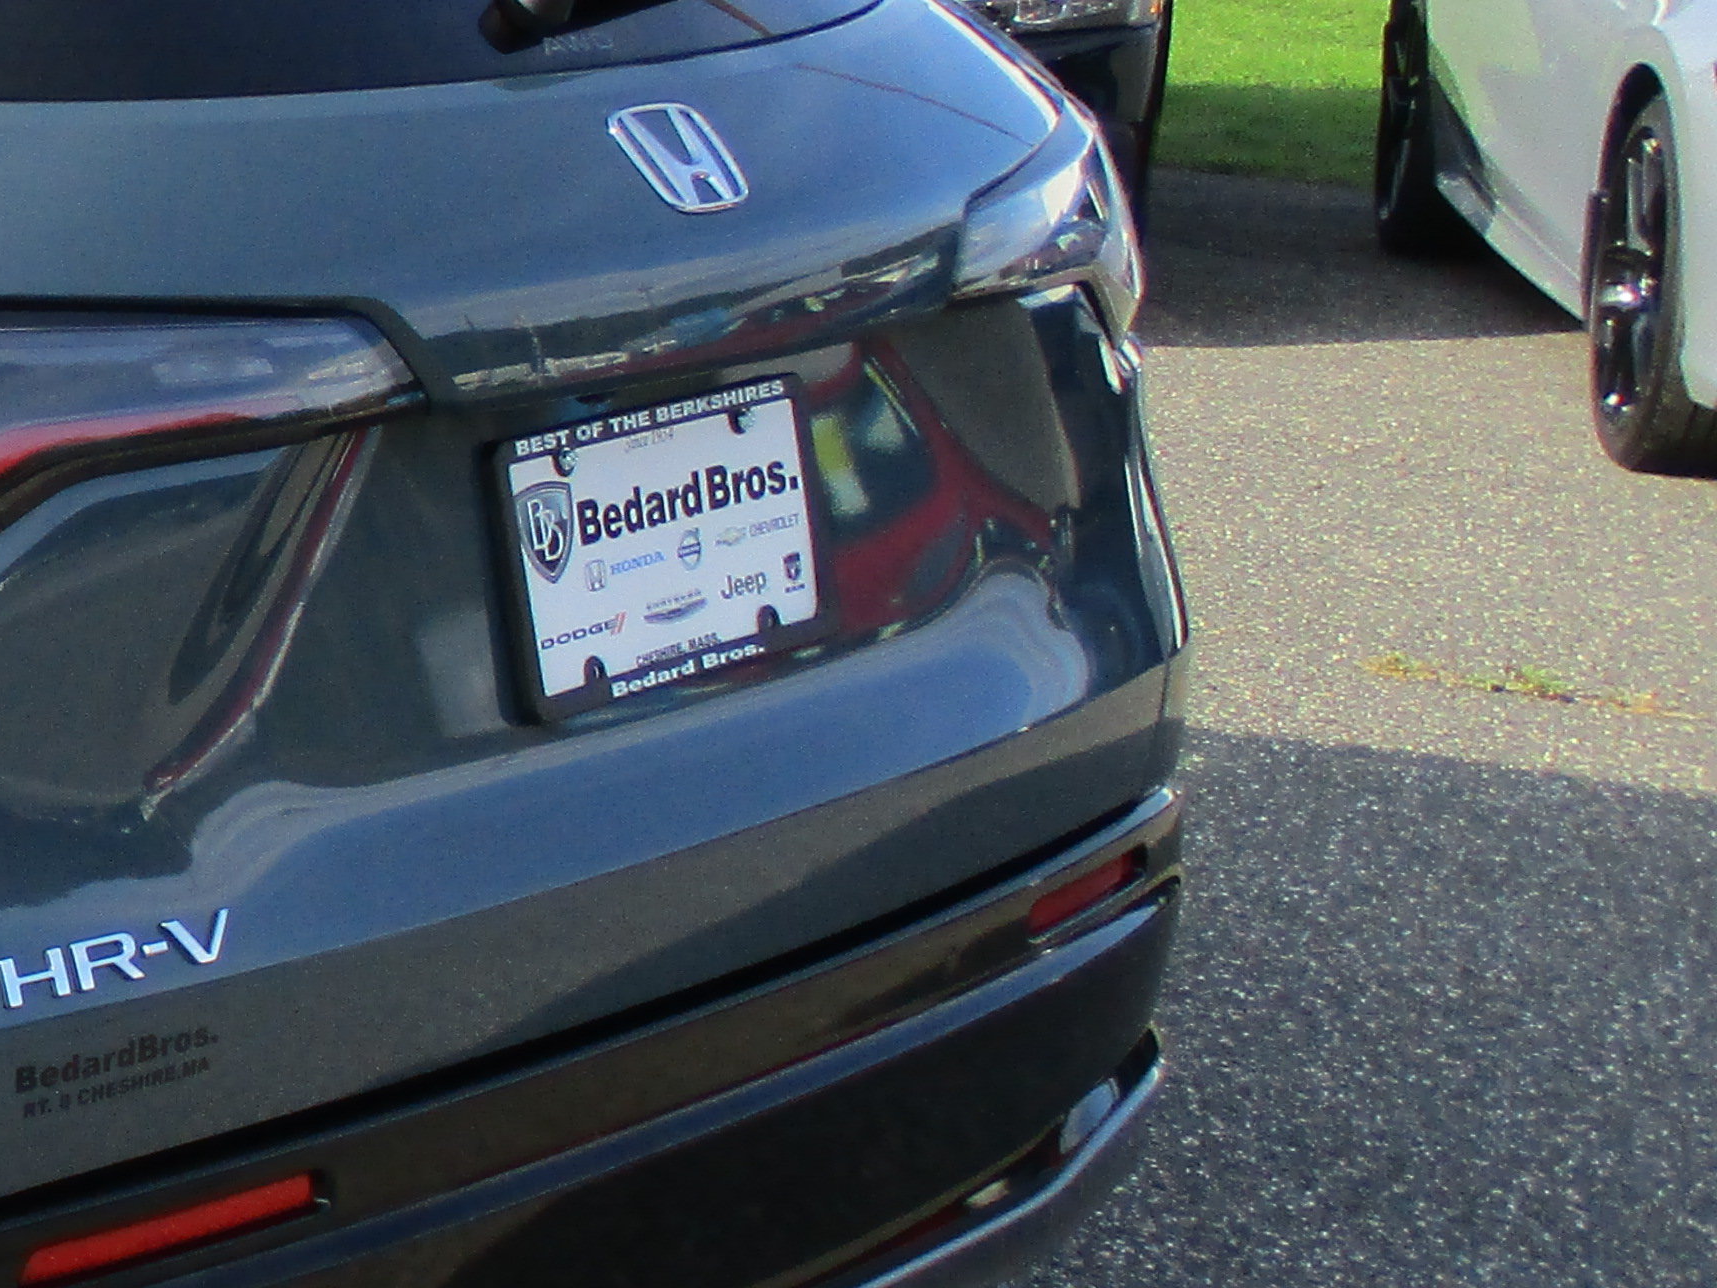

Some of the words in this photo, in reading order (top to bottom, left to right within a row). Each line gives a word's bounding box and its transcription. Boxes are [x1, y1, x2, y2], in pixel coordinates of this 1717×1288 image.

[515, 428, 570, 457] BEST
[576, 423, 605, 442] OF
[608, 412, 652, 435] THE
[655, 379, 784, 423] BERKSHIRES
[610, 550, 665, 576] HONDA
[719, 571, 767, 600] Jeep
[540, 617, 617, 650] DODGE
[610, 659, 696, 699] Bedard
[701, 643, 766, 670] Bros.
